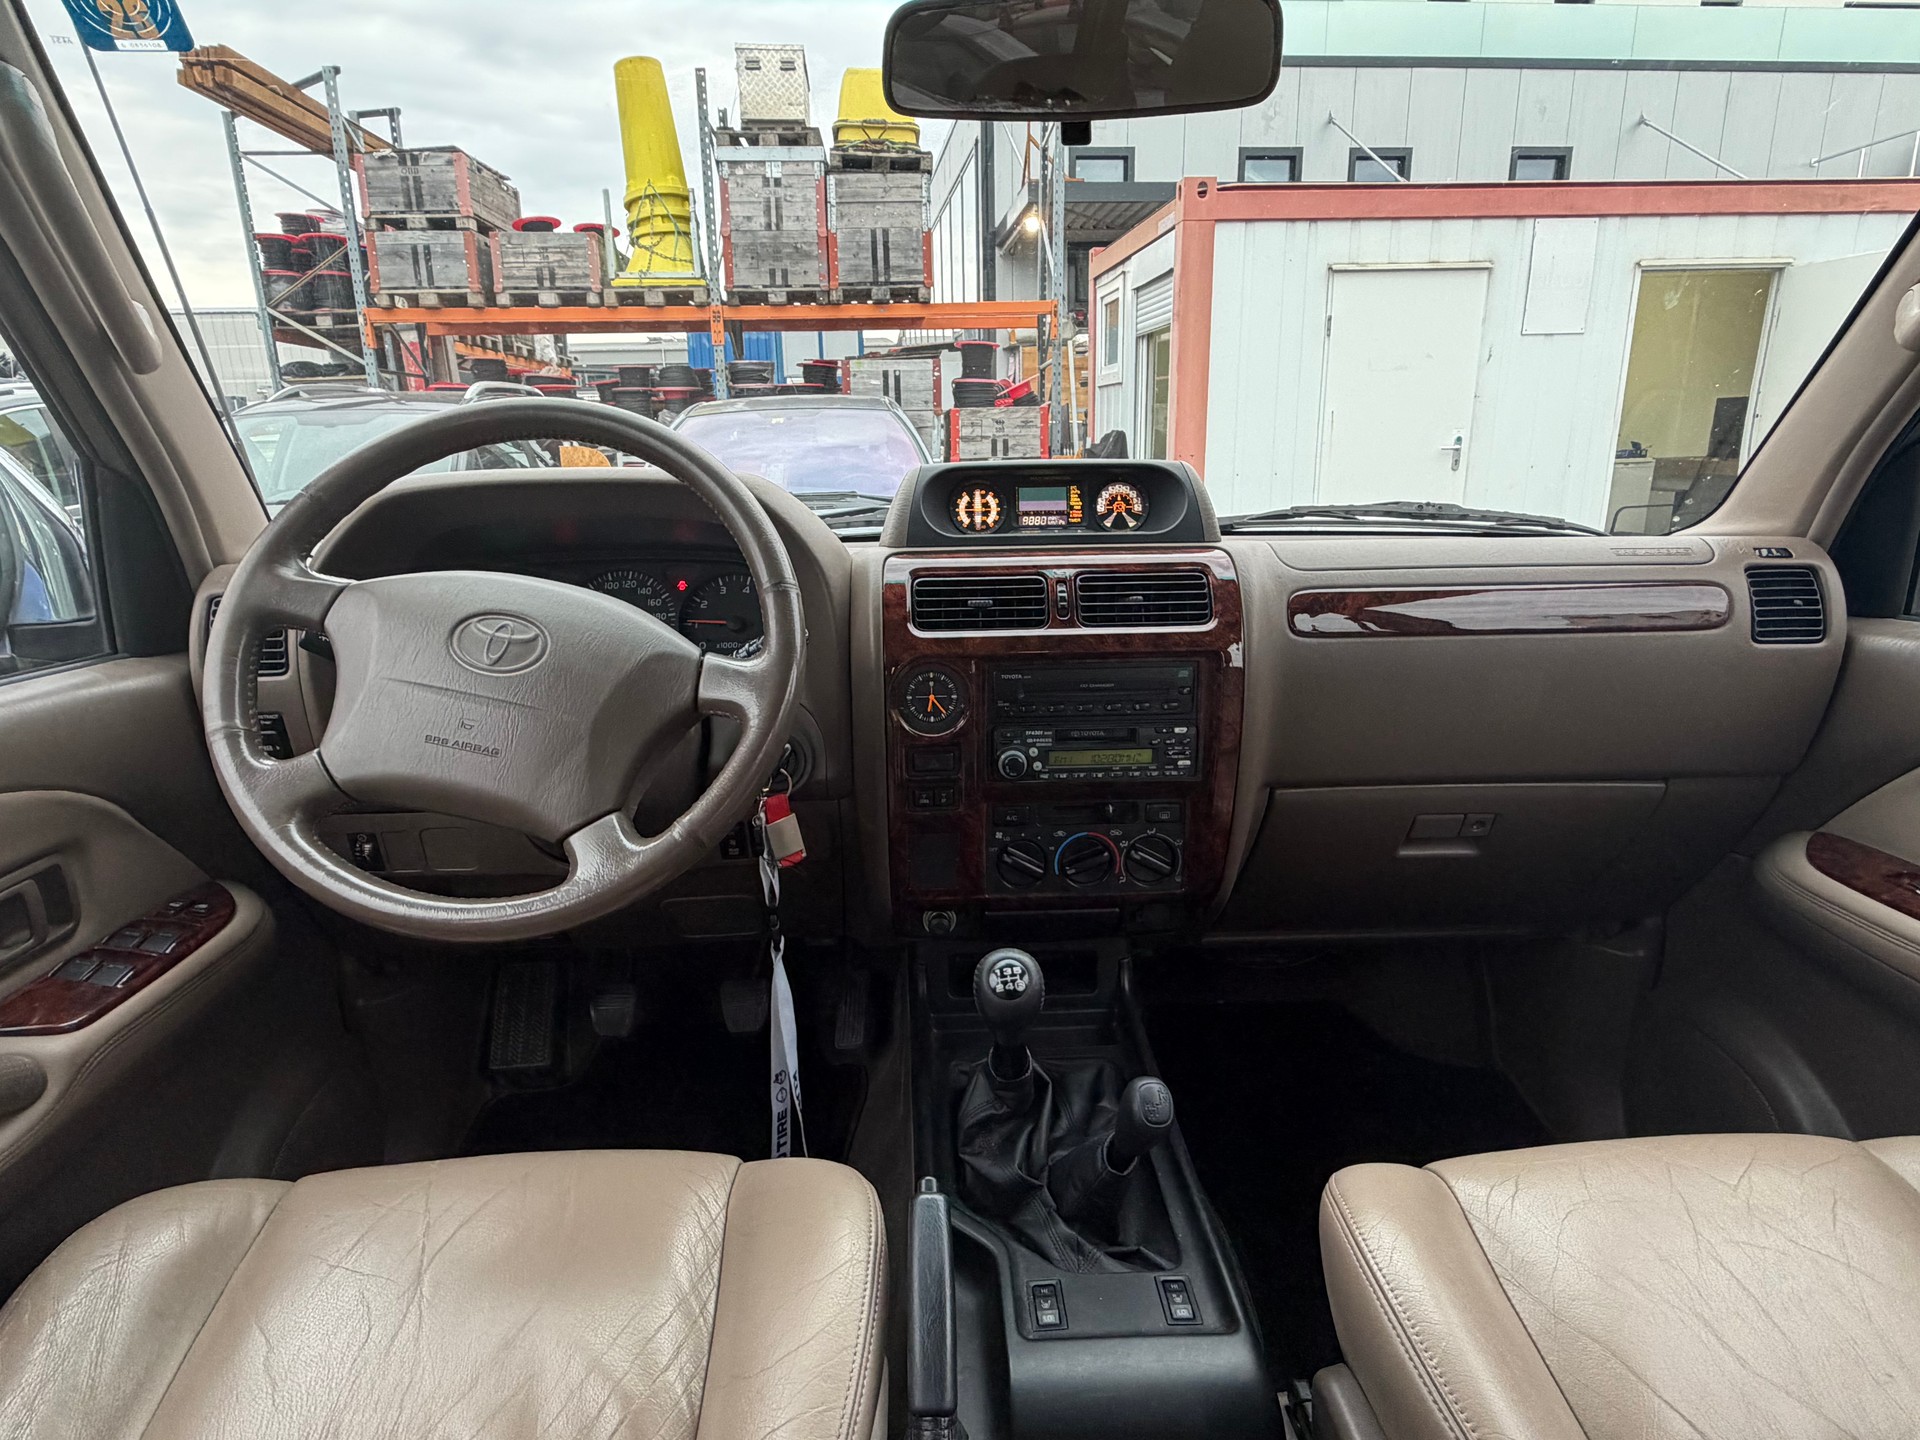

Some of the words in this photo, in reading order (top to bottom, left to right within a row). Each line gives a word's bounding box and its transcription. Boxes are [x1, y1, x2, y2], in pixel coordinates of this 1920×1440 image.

[604, 581, 619, 590] 100
[622, 580, 637, 588] 120
[637, 587, 652, 595] 140
[719, 586, 727, 595] 3
[743, 586, 751, 594] 4
[647, 599, 662, 607] 160
[700, 600, 708, 609] 2
[425, 734, 449, 745] SRS
[452, 740, 501, 756] AIRBAG
[994, 968, 1001, 976] 1
[1003, 967, 1012, 976] 3
[1013, 966, 1022, 974] 5
[996, 983, 1005, 993] 2
[1005, 982, 1014, 990] 4
[776, 1107, 788, 1153] TIRE
